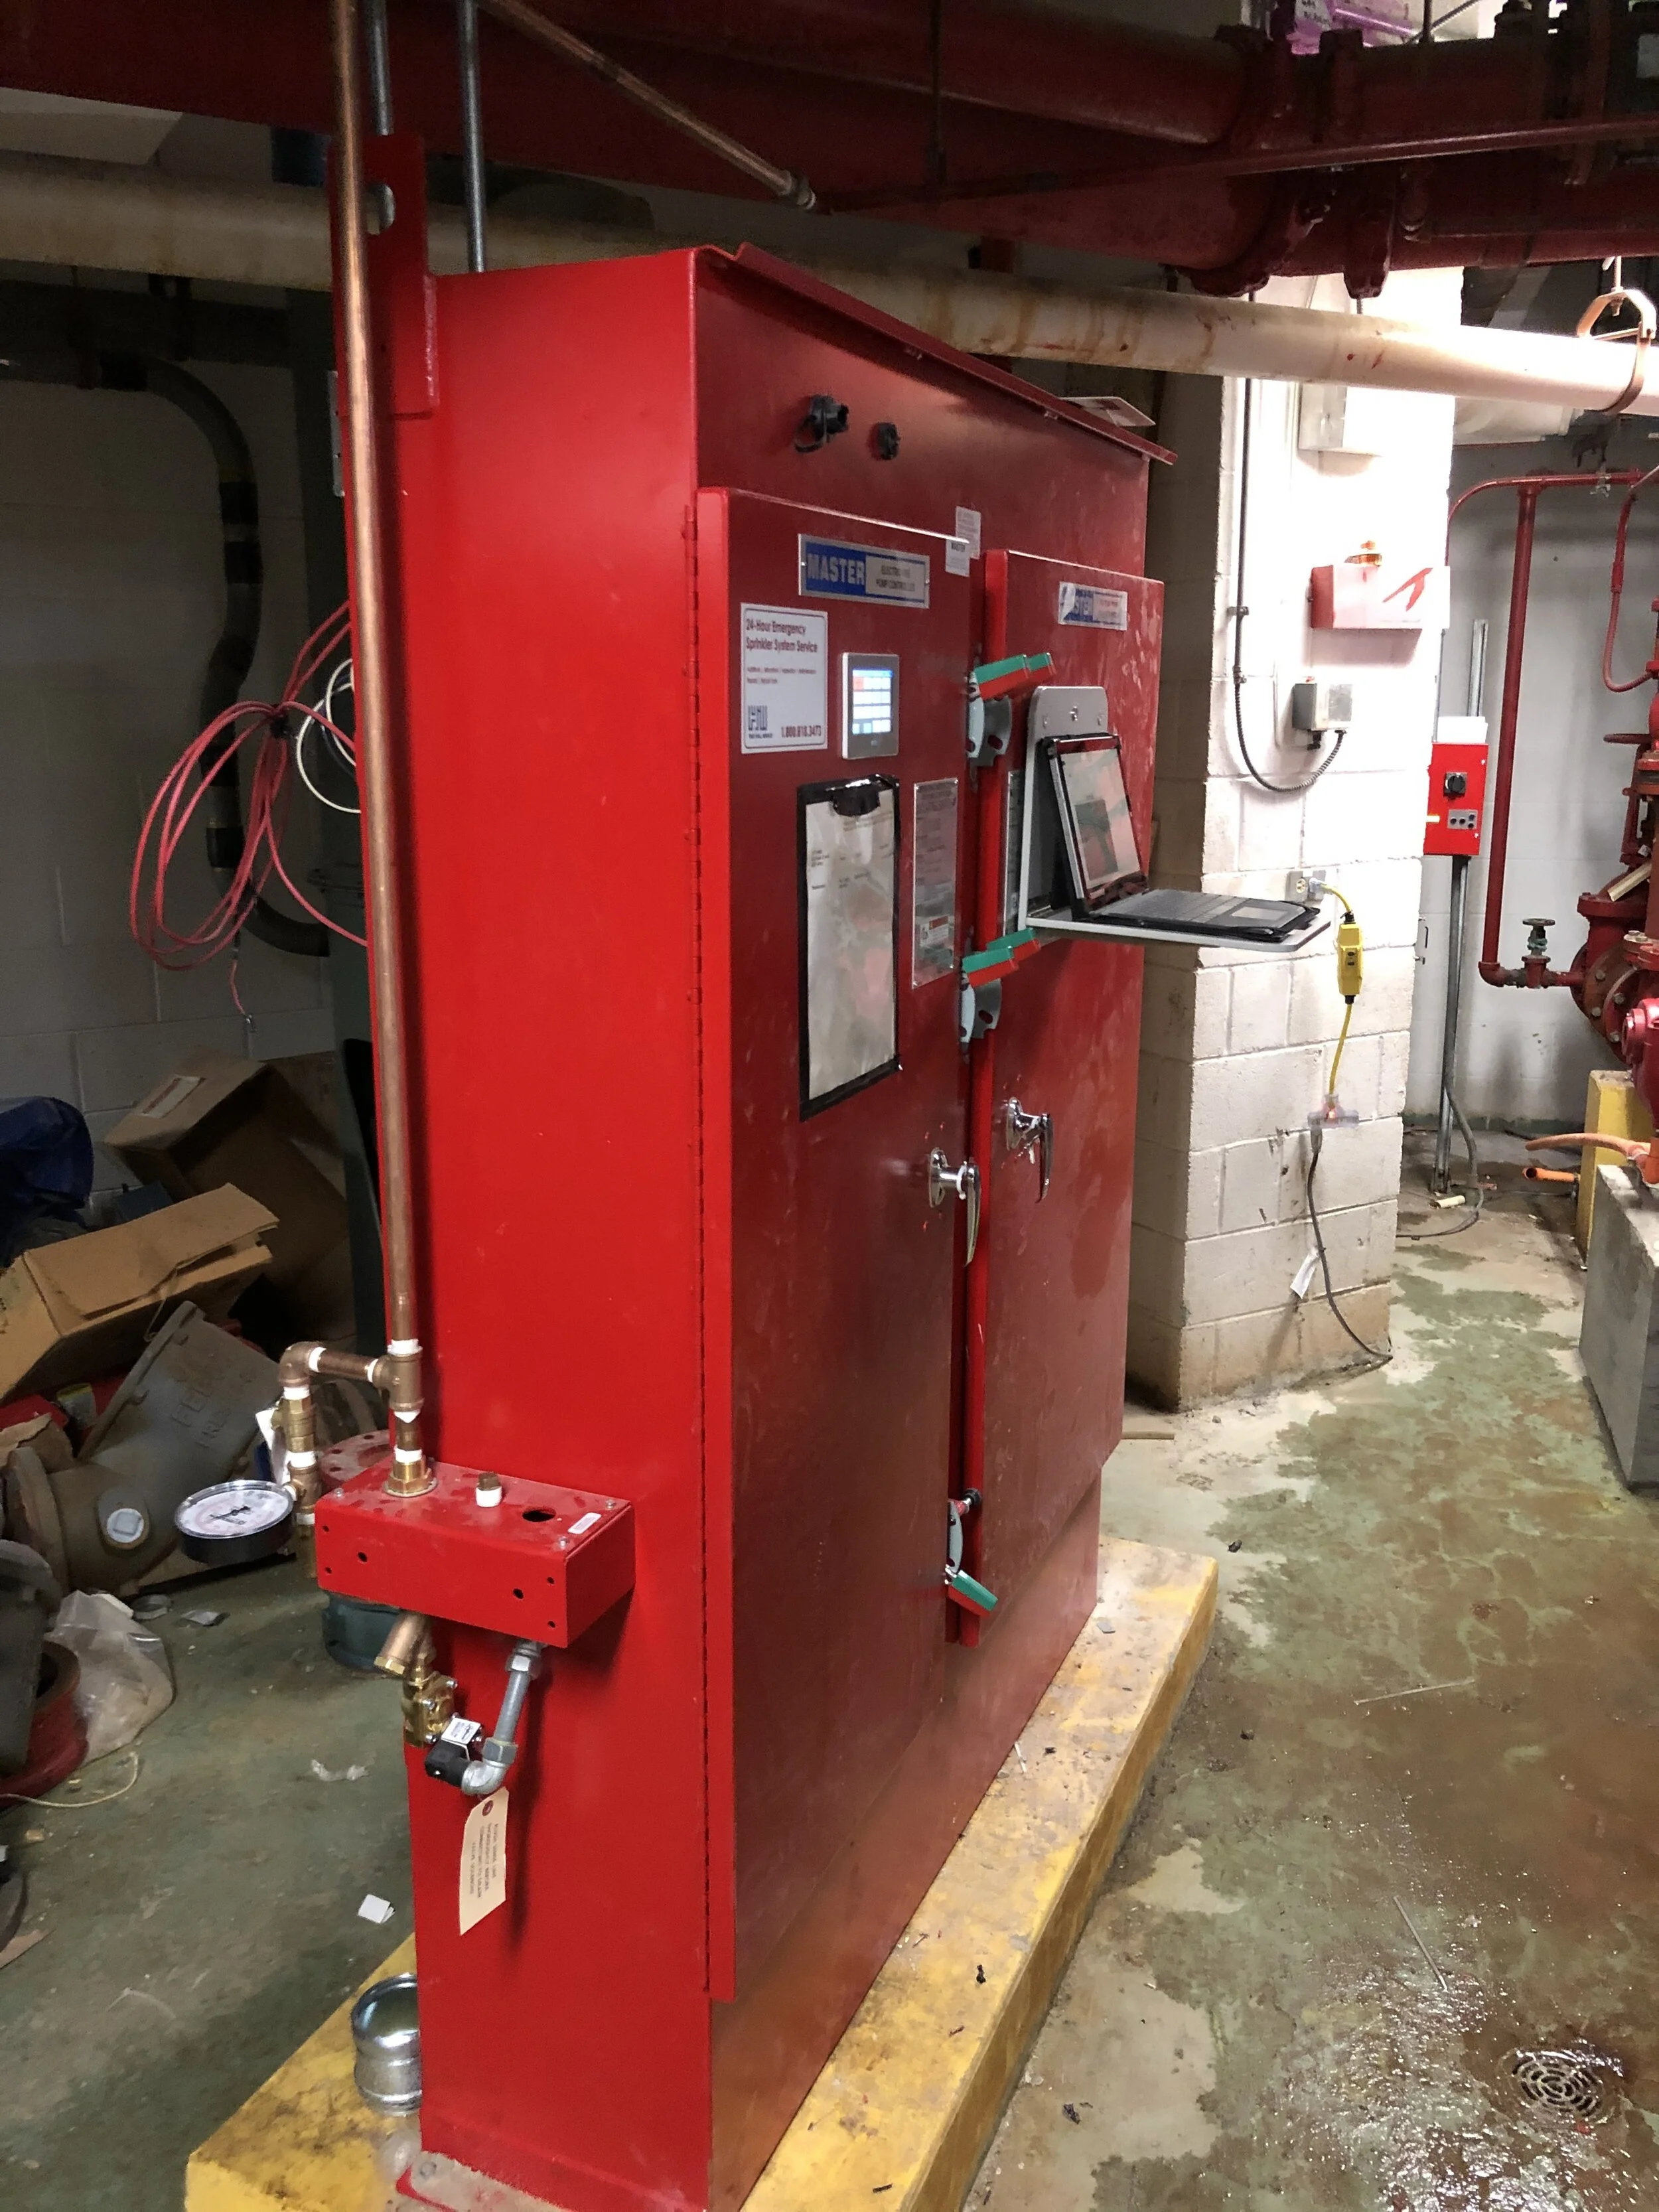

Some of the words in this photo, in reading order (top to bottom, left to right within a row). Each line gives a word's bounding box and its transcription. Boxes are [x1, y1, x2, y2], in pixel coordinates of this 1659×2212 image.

[807, 552, 865, 585] MASTER
[746, 618, 770, 632] 24-Hour
[772, 621, 806, 636] Emergency
[746, 636, 772, 651] Sprinkler
[774, 638, 796, 653] System
[796, 640, 818, 653] Service
